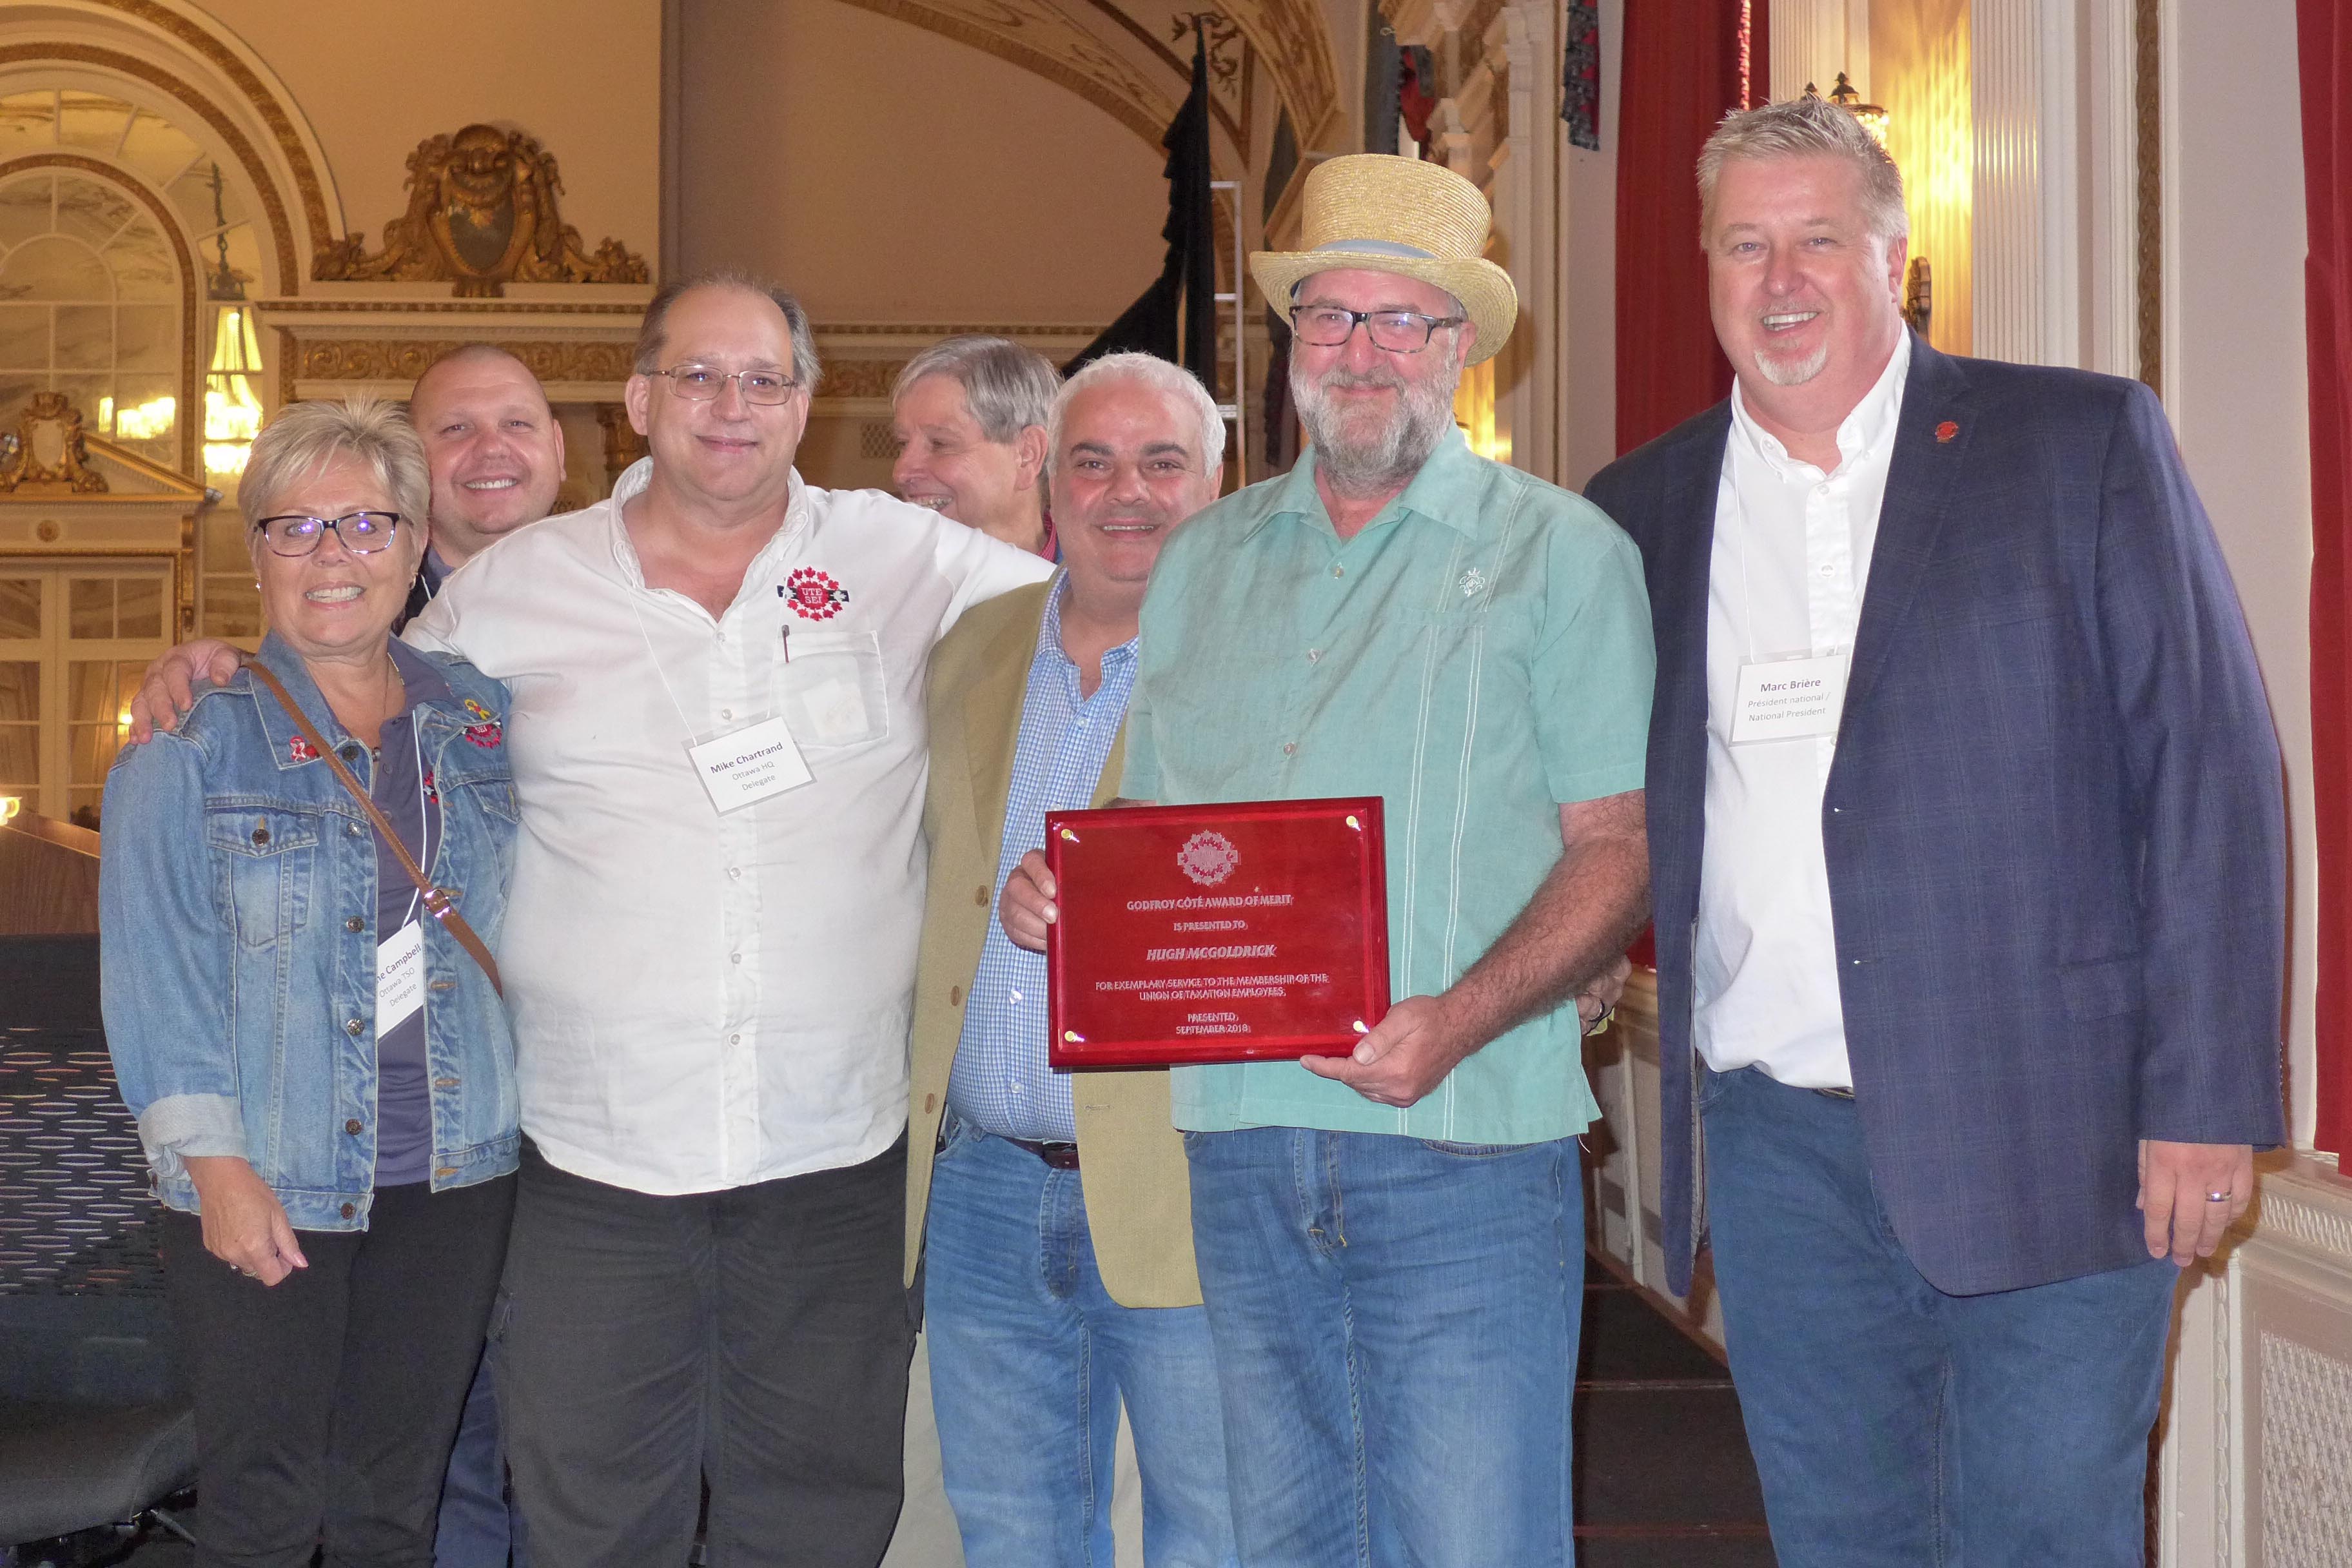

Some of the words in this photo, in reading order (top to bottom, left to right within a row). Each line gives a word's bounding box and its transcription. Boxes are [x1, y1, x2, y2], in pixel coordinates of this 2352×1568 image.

[801, 587, 823, 596] UTE
[1760, 683, 1787, 692] Marc
[1790, 678, 1821, 689] Brière
[1748, 698, 1787, 708] Président
[1790, 692, 1824, 703] national
[1749, 711, 1785, 721] National
[1787, 707, 1826, 718] President
[710, 760, 735, 774] Mike
[736, 742, 783, 765] Chartrand
[732, 766, 761, 780] Ottawa
[761, 761, 775, 770] HQ
[741, 774, 776, 791] Delegate
[1127, 899, 1175, 910] GODFROY
[1176, 896, 1204, 908] CÔTÉ
[1205, 897, 1244, 906] AWARD
[1244, 896, 1259, 905] OF
[1260, 894, 1293, 904] MERIT
[1173, 923, 1182, 931] IS
[1183, 921, 1231, 930] PRESENTED
[1233, 920, 1246, 928] TO
[386, 943, 422, 974] Campbell
[1146, 948, 1185, 960] HUGH
[1187, 945, 1276, 959] MCGOLDRICK
[379, 977, 402, 998] Ottawa
[401, 967, 415, 979] TSO
[1095, 982, 1113, 990] FOR
[1114, 979, 1166, 990] EXEMPLARY
[1167, 978, 1202, 988] SERVICE
[1203, 977, 1217, 986] TO
[1218, 977, 1235, 986] THE
[1236, 974, 1295, 985] MEMBERSHIP
[1295, 974, 1310, 983] OF
[1310, 973, 1329, 983] THE
[389, 983, 418, 1007] Delegate
[1139, 991, 1170, 1001] UNION
[1171, 990, 1185, 999] OF
[1185, 989, 1230, 999] TAXATION
[1188, 1012, 1237, 1023] PRESENTED
[1176, 1025, 1226, 1034] SEPTEMBER
[1227, 1024, 1250, 1033] 2018
